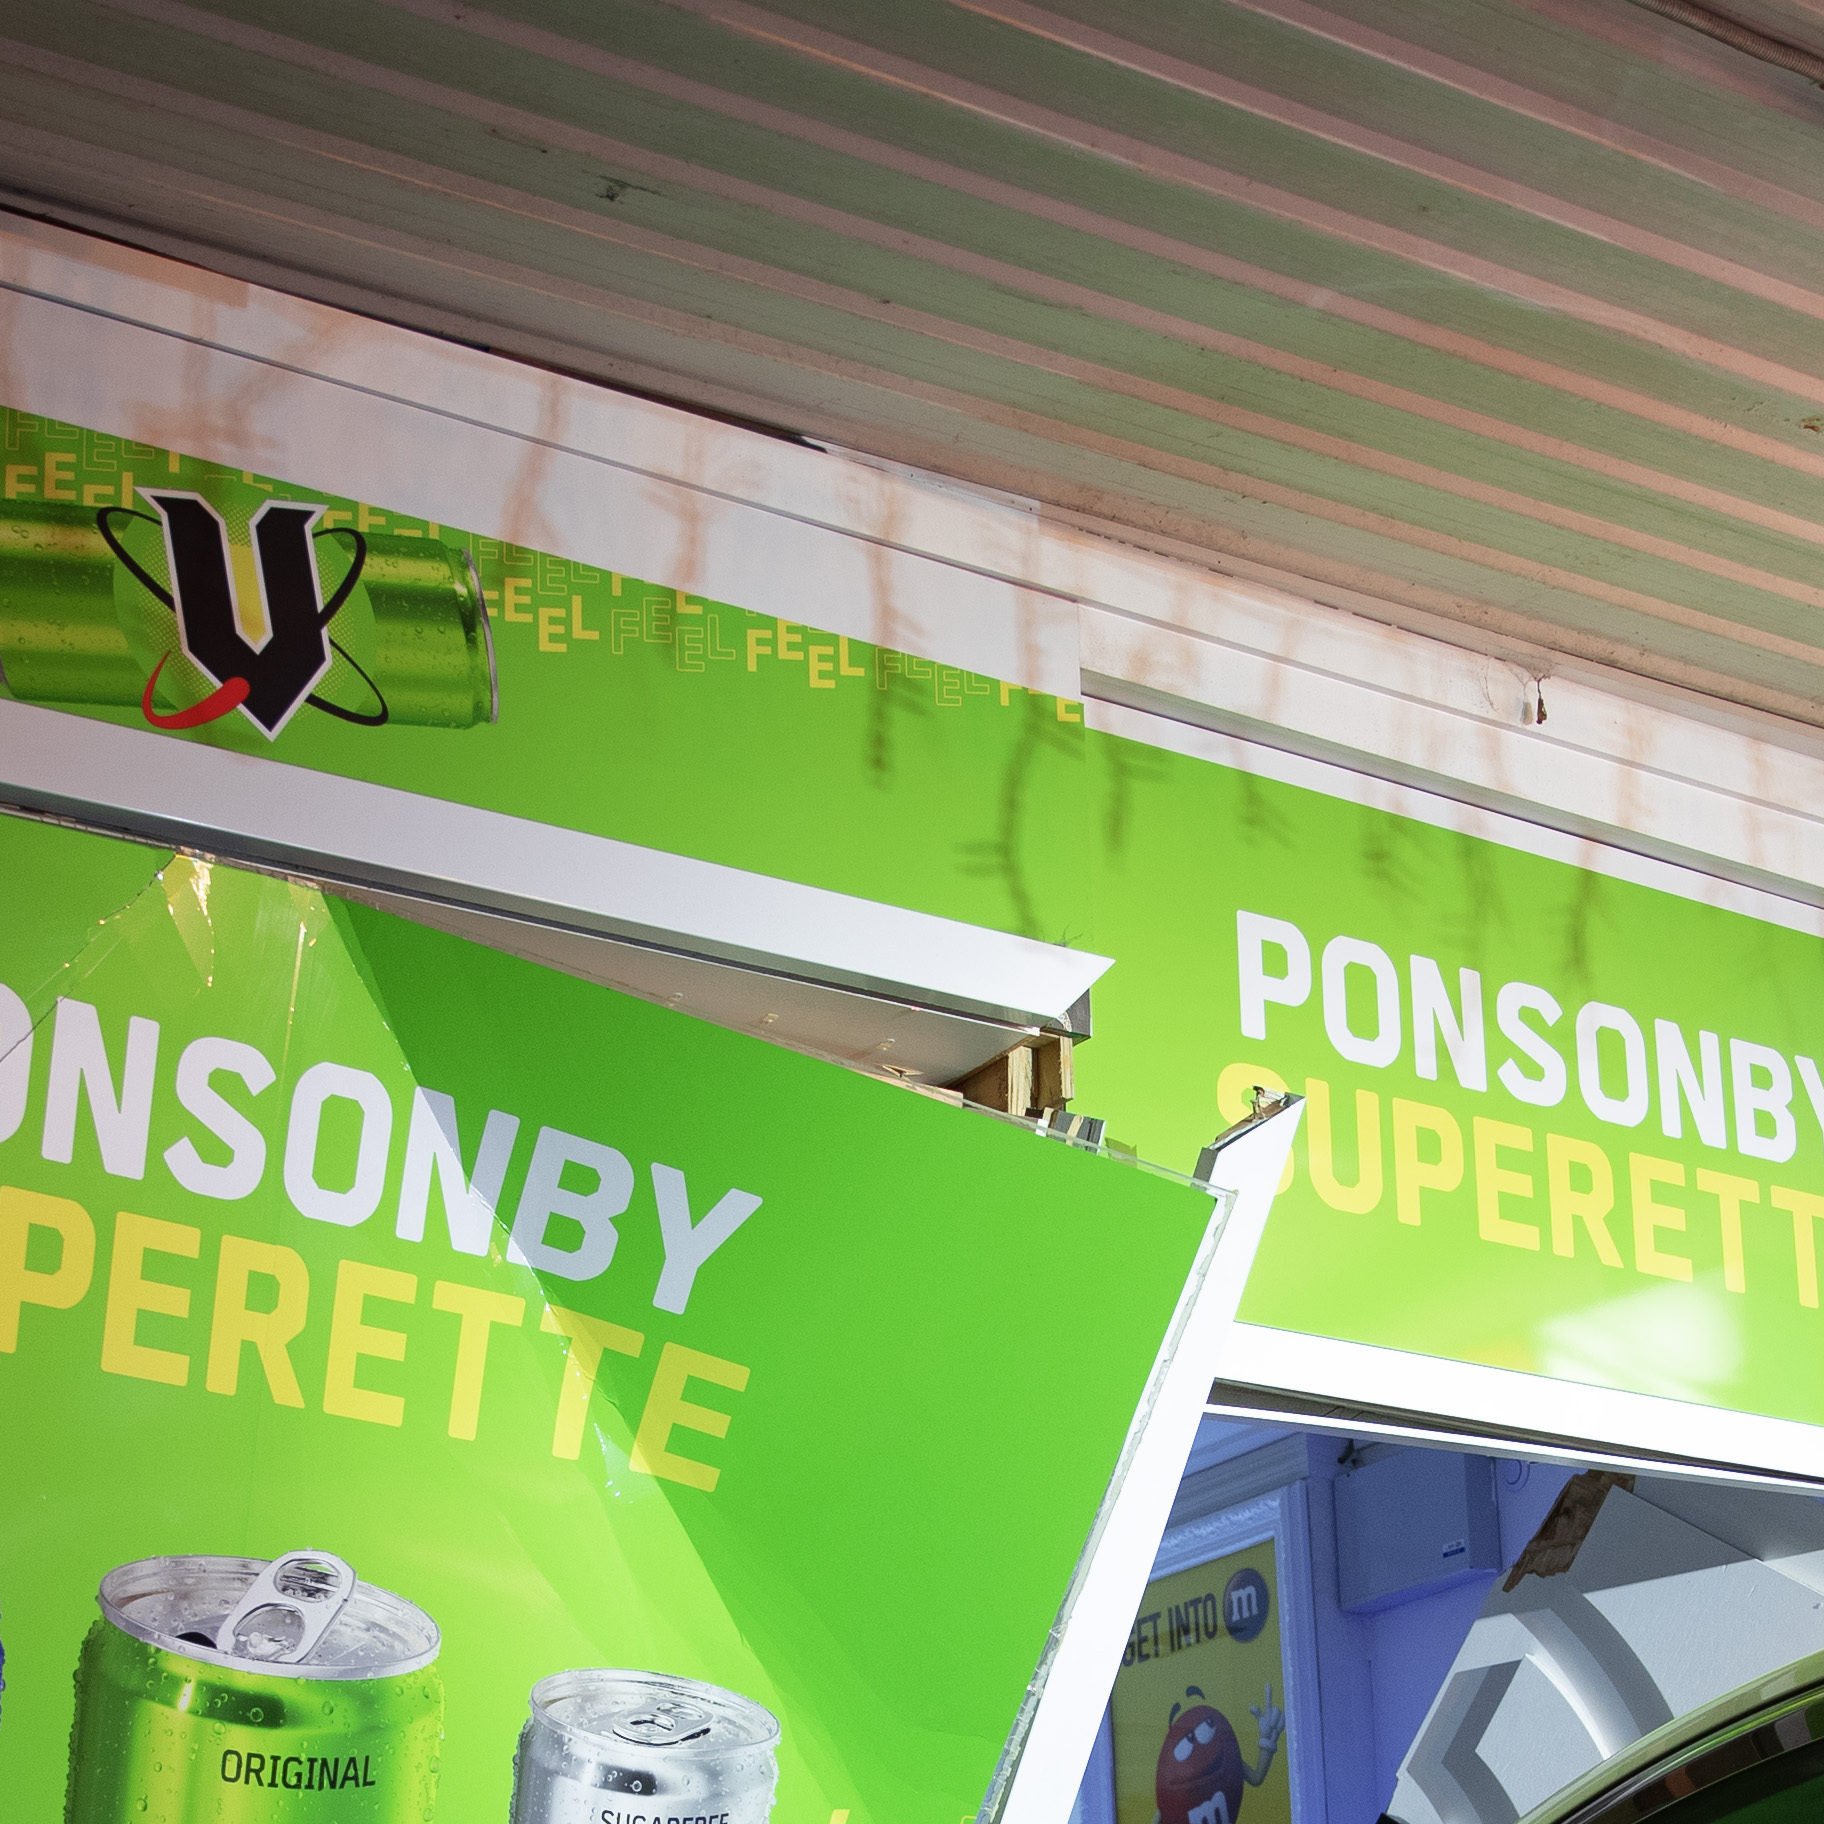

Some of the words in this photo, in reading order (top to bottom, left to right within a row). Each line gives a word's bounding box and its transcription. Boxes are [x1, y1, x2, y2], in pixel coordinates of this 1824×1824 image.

[136, 487, 329, 741] V
[612, 597, 735, 672] FEEL
[746, 619, 865, 688] FEEL
[1168, 1593, 1218, 1653] INTO
[220, 1748, 377, 1791] ORIGINAL
